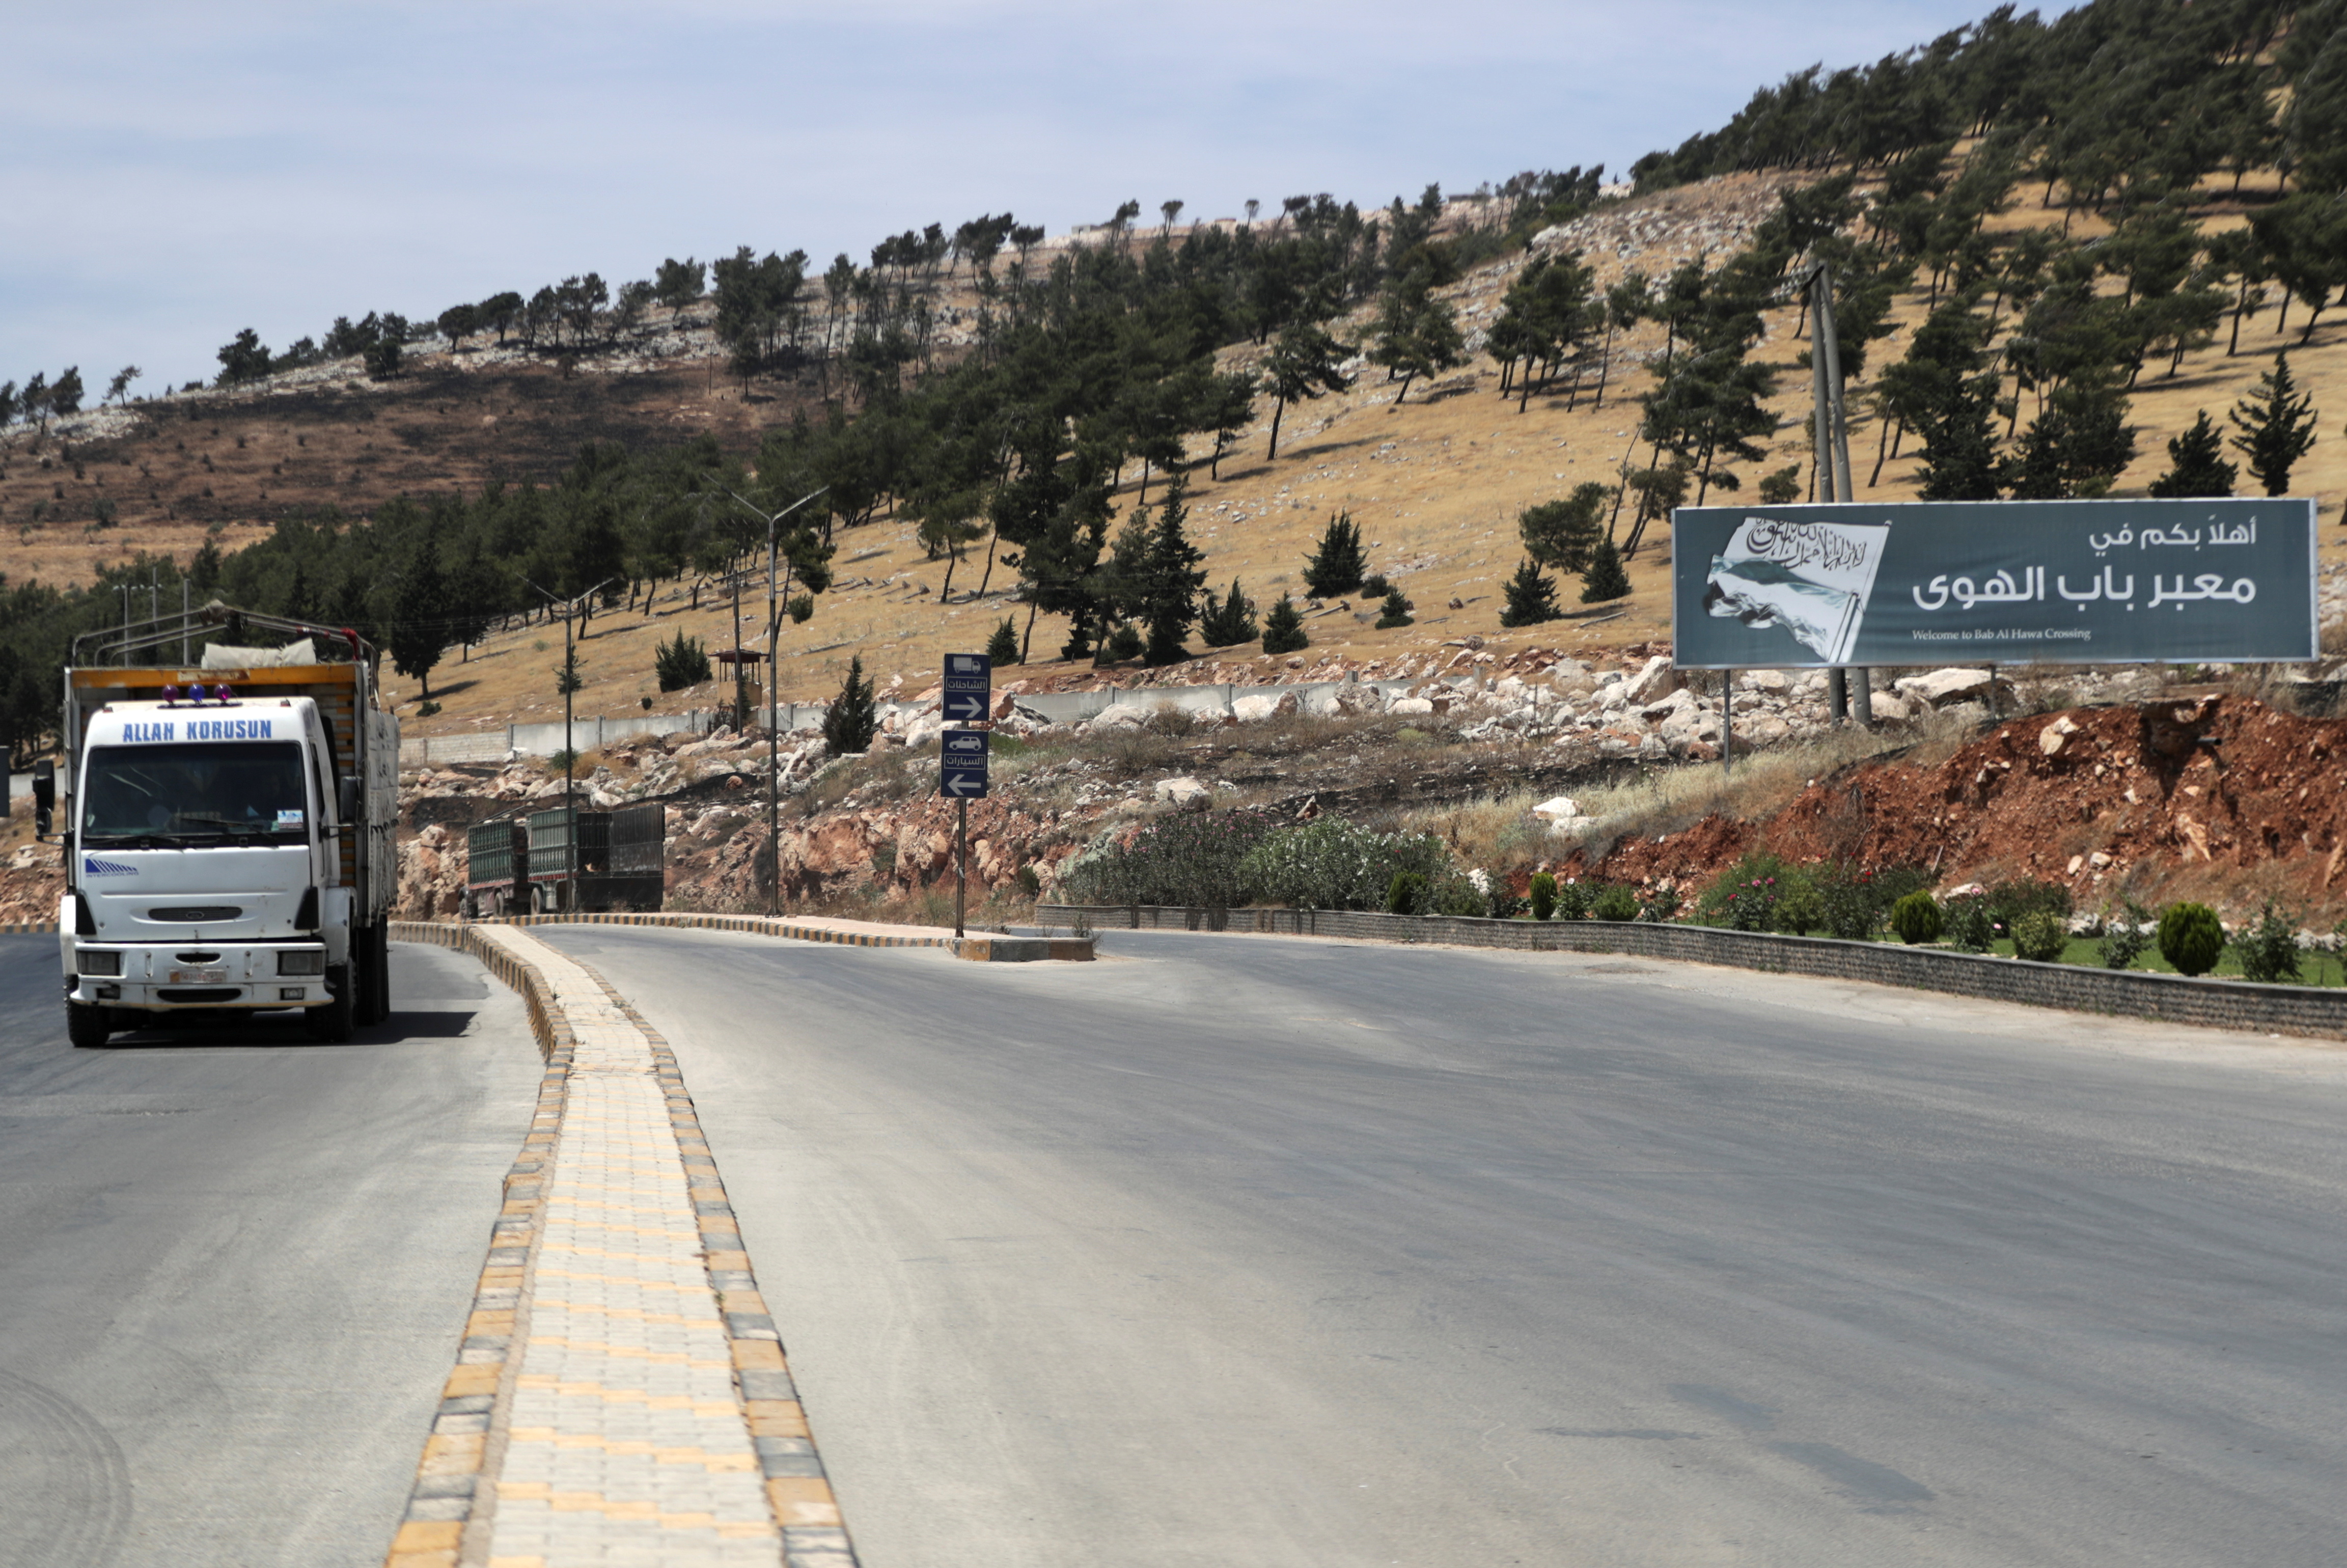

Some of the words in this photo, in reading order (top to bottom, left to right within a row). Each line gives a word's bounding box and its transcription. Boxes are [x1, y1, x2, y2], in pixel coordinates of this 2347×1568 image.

[2089, 522, 2134, 557] في
[2140, 522, 2201, 552] بكم
[1912, 566, 2045, 611] الهوى
[2057, 565, 2134, 612] باب
[2147, 573, 2256, 611] معبر
[1912, 630, 1959, 640] Welcome
[1962, 630, 1972, 640] to
[1974, 629, 1994, 640] Bab
[1996, 628, 2009, 639] Al
[2011, 629, 2042, 639] Hawa
[2045, 628, 2091, 641] Crossing
[948, 680, 985, 690] الشاحنات
[123, 722, 174, 742] ALLAH
[186, 720, 272, 740] KORUSUN
[947, 757, 983, 766] السيارات
